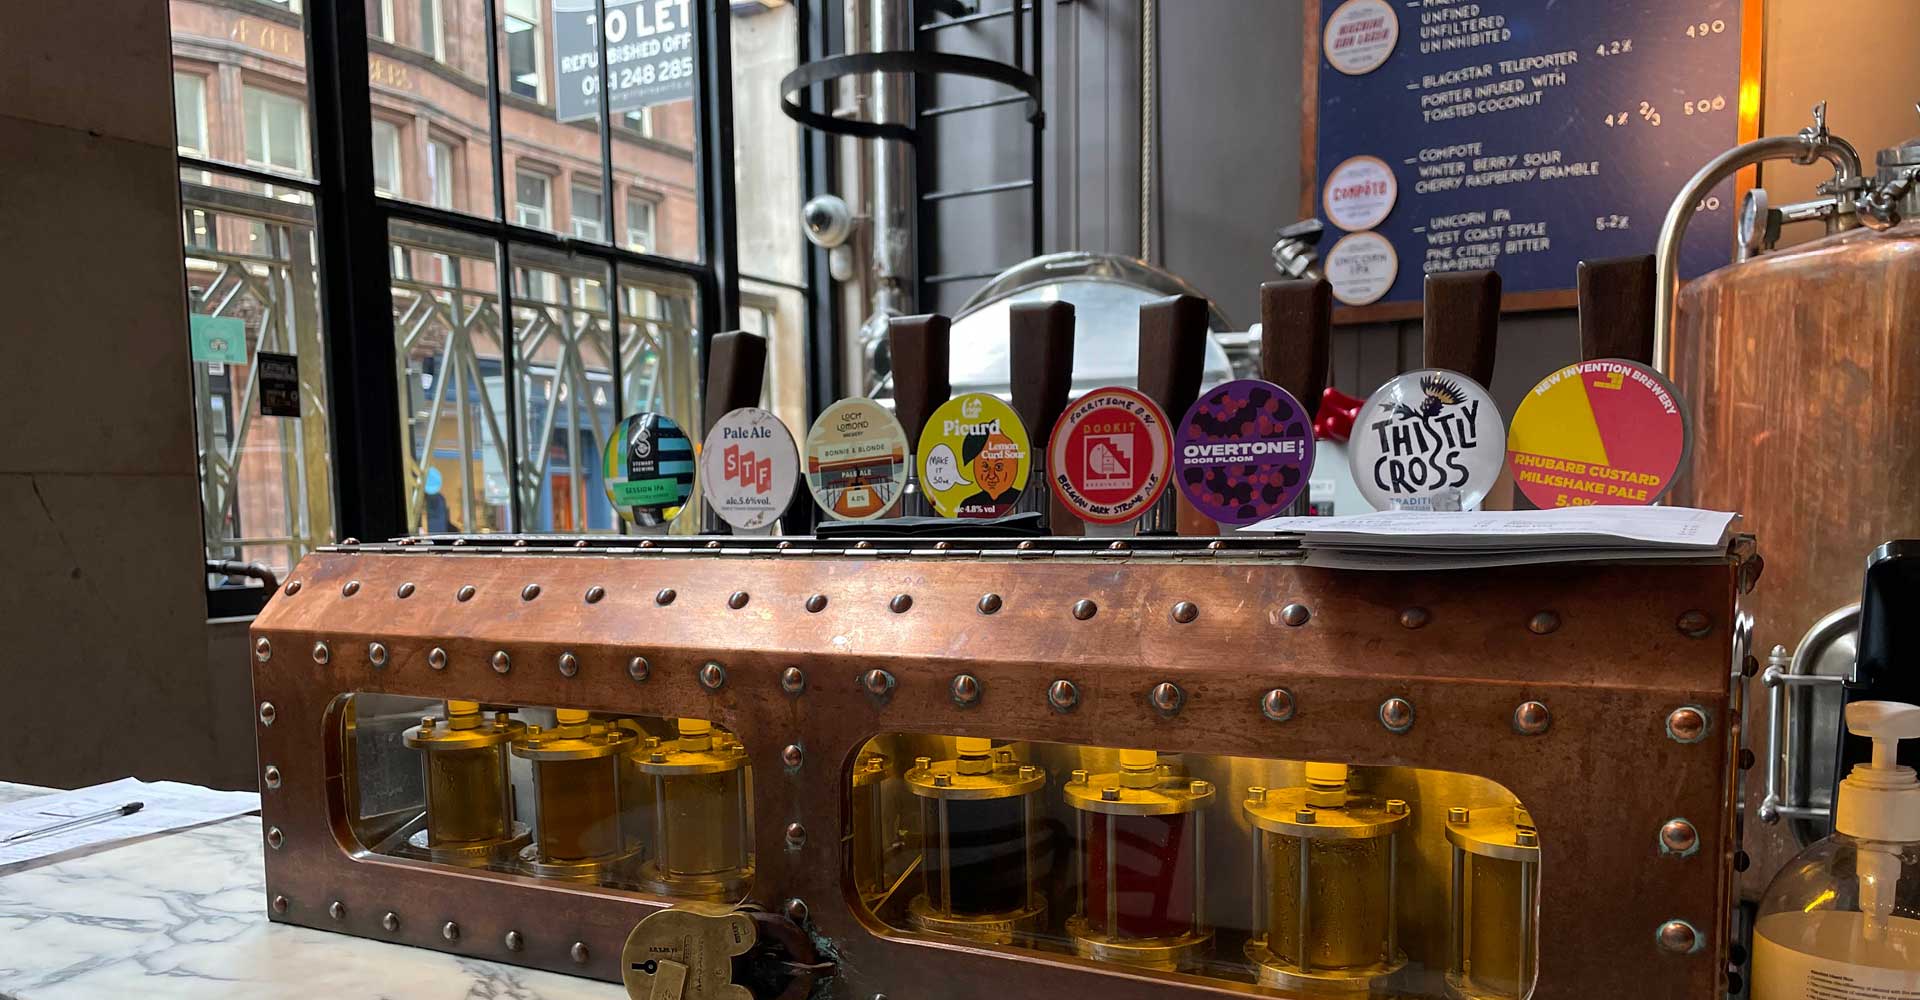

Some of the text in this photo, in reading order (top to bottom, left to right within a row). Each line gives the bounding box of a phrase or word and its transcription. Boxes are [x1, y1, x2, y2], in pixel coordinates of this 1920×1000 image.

[586, 0, 690, 43] TO LET
[1421, 4, 1480, 24] UNFINED
[1420, 15, 1505, 39] UNFILTERED
[1420, 28, 1511, 54] UNINHIBITED
[1596, 39, 1632, 57] 4.2%
[561, 39, 661, 74] REFUBISHED
[581, 71, 618, 96] 011
[620, 63, 656, 89] 248
[657, 56, 693, 82] 285
[1422, 50, 1578, 89] BLACKSTAR TELEPORTER
[1421, 71, 1566, 109] PORTER INFUSED WITH
[1422, 91, 1544, 124] TOASTED COCONUT
[1418, 142, 1483, 163] COMPOTE
[1418, 150, 1562, 178] WINTER BERRY SOUR
[1415, 161, 1600, 194] CHERRY RASPBERRY BRAMBLE
[1430, 208, 1512, 231] UNICORN IPA
[1426, 221, 1547, 246] WEST COAST STYLE
[1426, 237, 1550, 261] PINE CITRUS BITTER
[1535, 363, 1677, 415] NEW INVENTION BREWERY
[837, 421, 869, 432] LOMOND
[841, 412, 862, 422] LOCH
[943, 419, 1001, 437] Picurd
[1083, 421, 1136, 434] DOOKIT
[1371, 400, 1479, 457] THISTLY
[723, 426, 772, 439] Pale Ale
[825, 448, 850, 457] BONNIE
[858, 443, 885, 453] BLONDE
[981, 450, 1026, 459] Curd Sour
[988, 442, 1018, 451] Lemon
[1183, 441, 1296, 458] OVERTONE
[929, 455, 949, 466] MAKE
[1184, 455, 1254, 465] SOOR PLOOM
[1514, 454, 1660, 486] RHUBARB CUSTARD
[841, 468, 872, 479] PALE ALE
[1374, 451, 1470, 494] CROSS
[625, 484, 665, 495] SESSION IPA
[1089, 503, 1110, 514] DARK
[1143, 473, 1159, 496] ALE
[1519, 470, 1648, 501] MILKSHAKE PALE
[965, 505, 983, 513] 4.8%
[984, 505, 995, 513] vol
